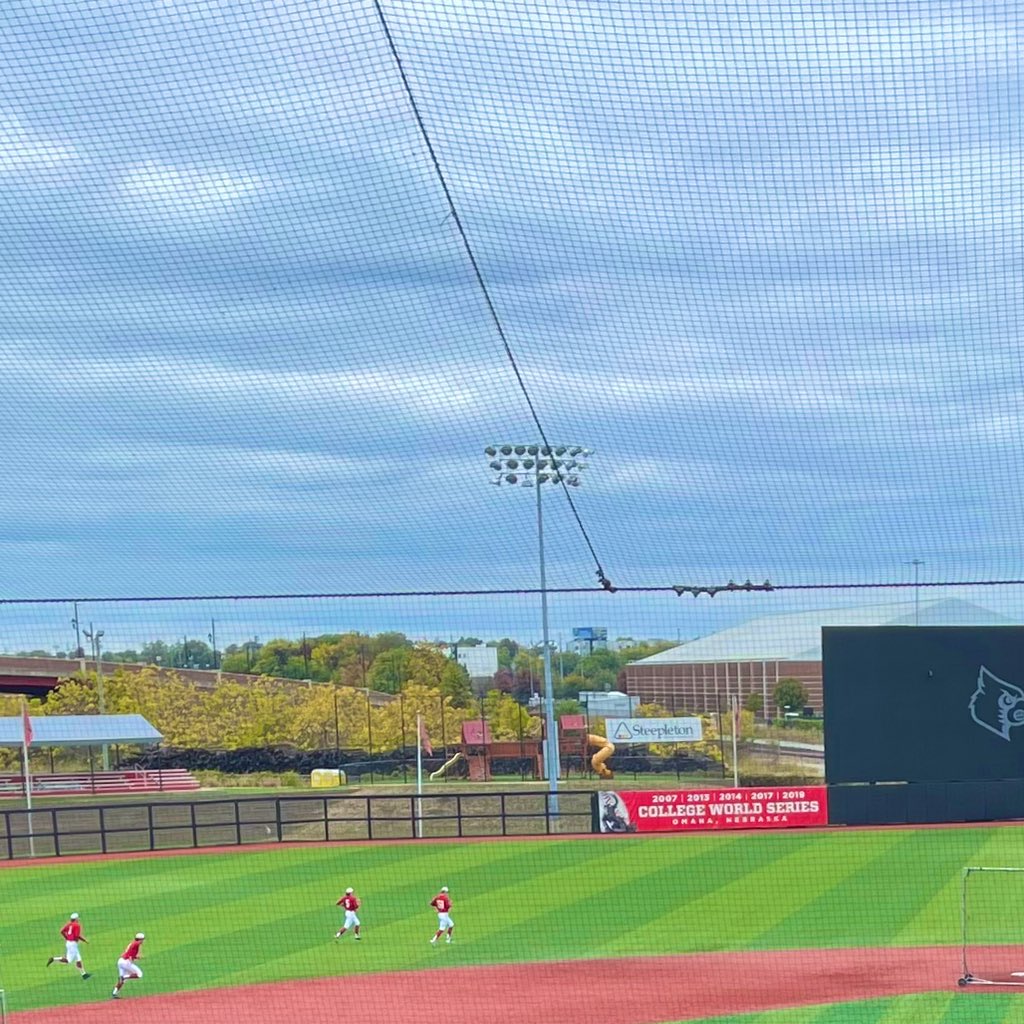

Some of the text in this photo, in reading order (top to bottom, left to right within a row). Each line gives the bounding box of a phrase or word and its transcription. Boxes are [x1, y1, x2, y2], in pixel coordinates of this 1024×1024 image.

[632, 724, 694, 738] Steepleton
[652, 795, 678, 803] 2007
[687, 794, 710, 802] 2013
[719, 793, 742, 801] 2014
[751, 792, 773, 800] 2017
[638, 800, 819, 818] COLLEGE WORLD SERIES
[726, 815, 788, 823] NEBRASKA
